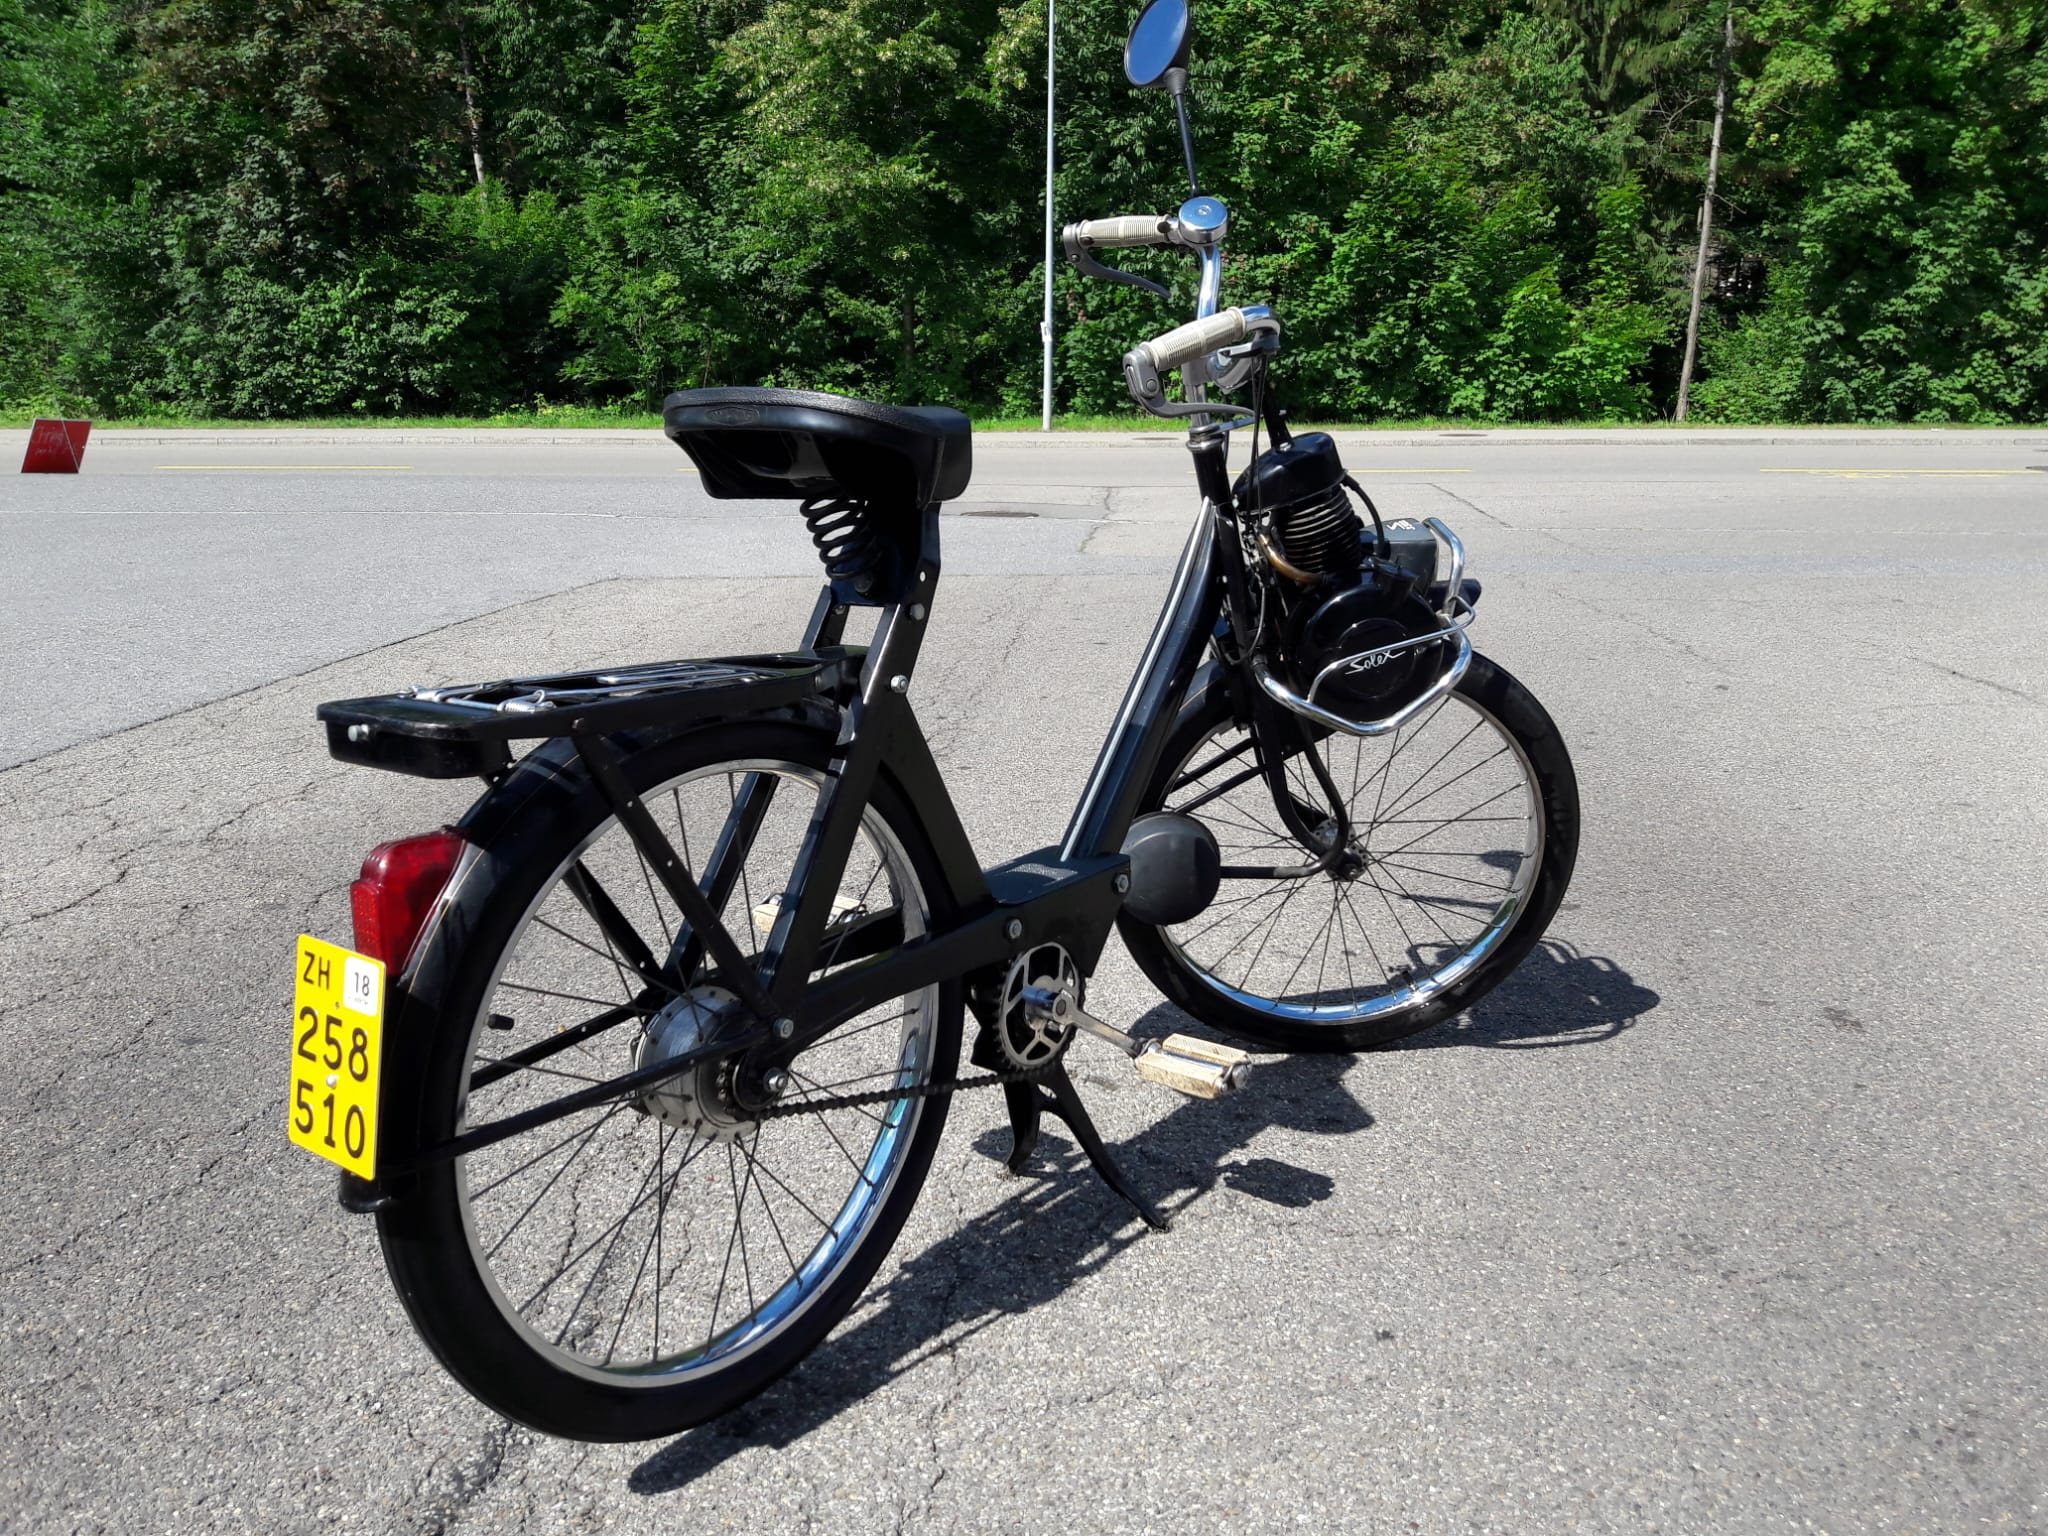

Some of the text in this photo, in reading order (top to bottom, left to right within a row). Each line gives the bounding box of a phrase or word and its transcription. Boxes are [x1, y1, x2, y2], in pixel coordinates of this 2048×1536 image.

[303, 951, 330, 990] ZH
[354, 971, 370, 997] 18
[297, 1005, 369, 1082] 258
[295, 1078, 366, 1159] 510
